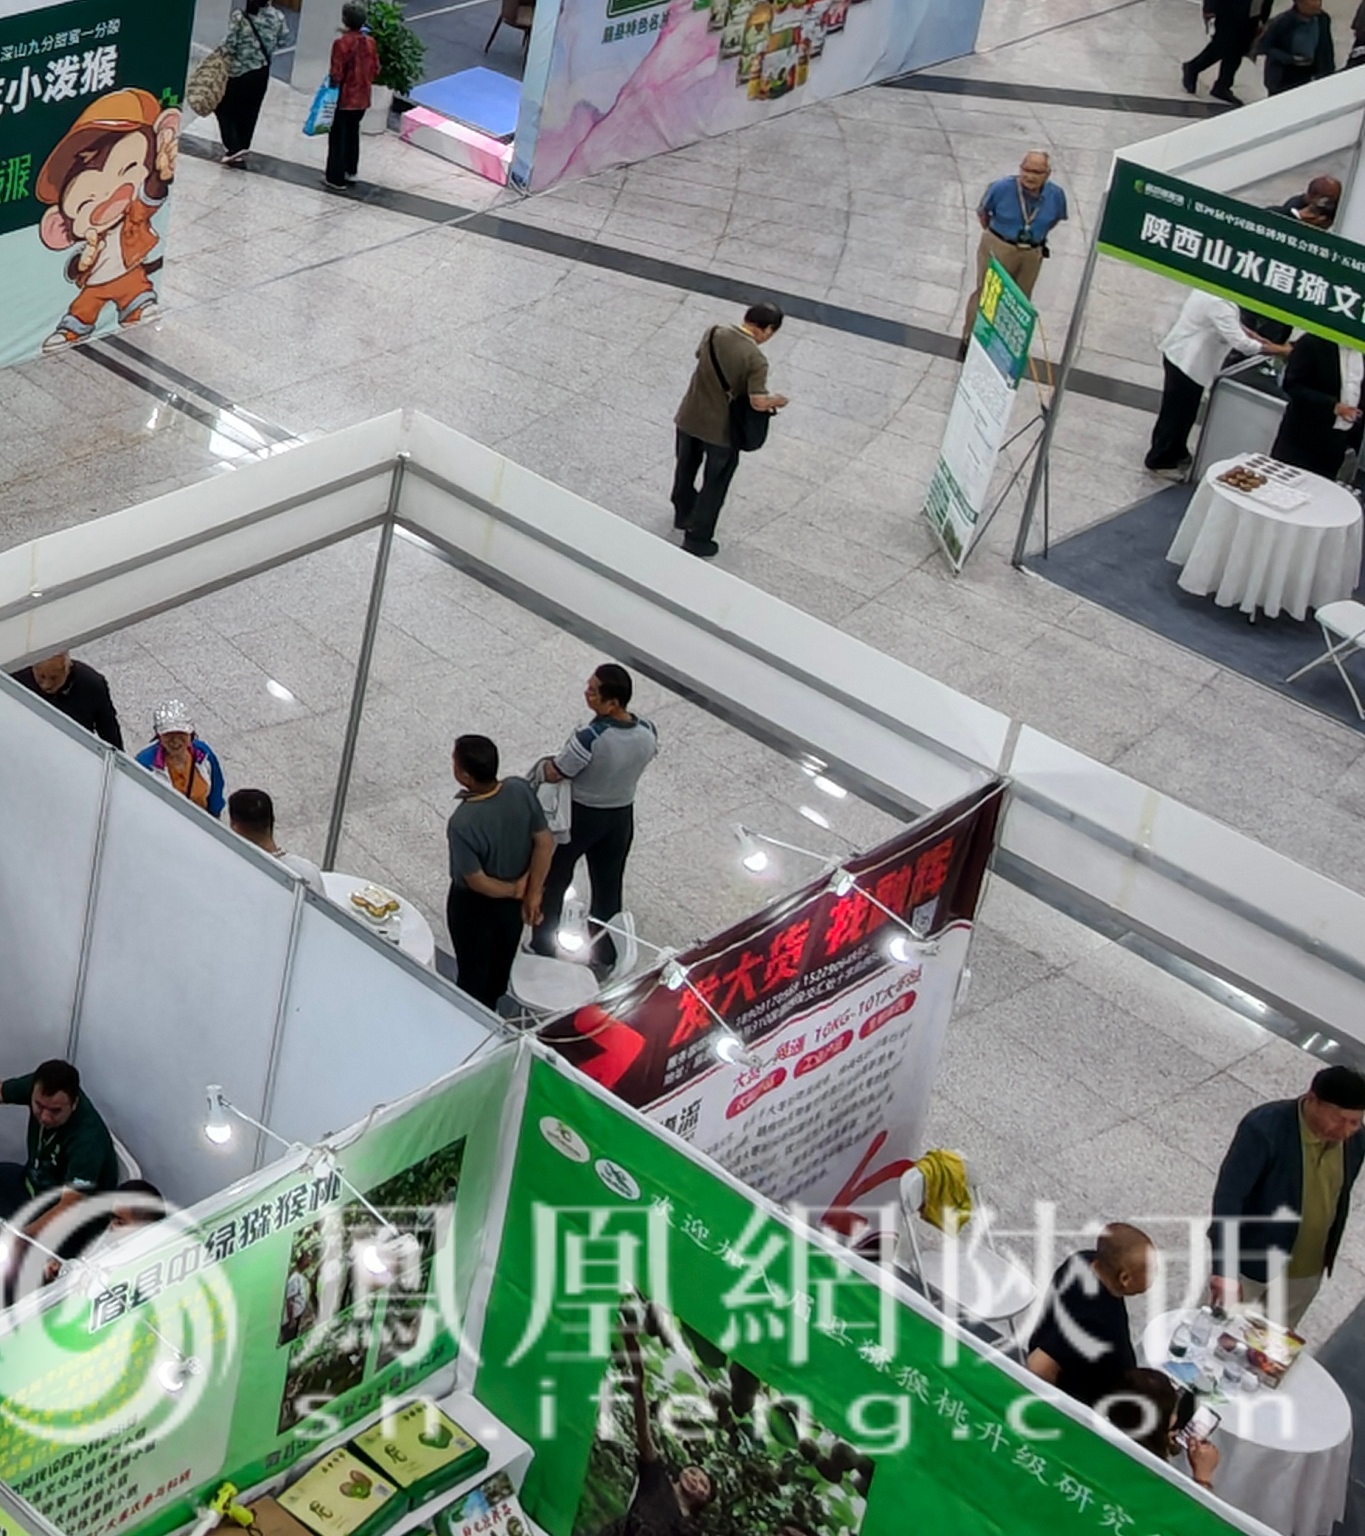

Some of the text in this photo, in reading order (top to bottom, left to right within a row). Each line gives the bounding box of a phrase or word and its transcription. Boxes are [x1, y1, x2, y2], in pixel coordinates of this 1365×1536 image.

[1140, 212, 1365, 323] 陕西山水眉猕文
[648, 1191, 1169, 1536] 欢迎加入眉县猕猴桃升级研究
